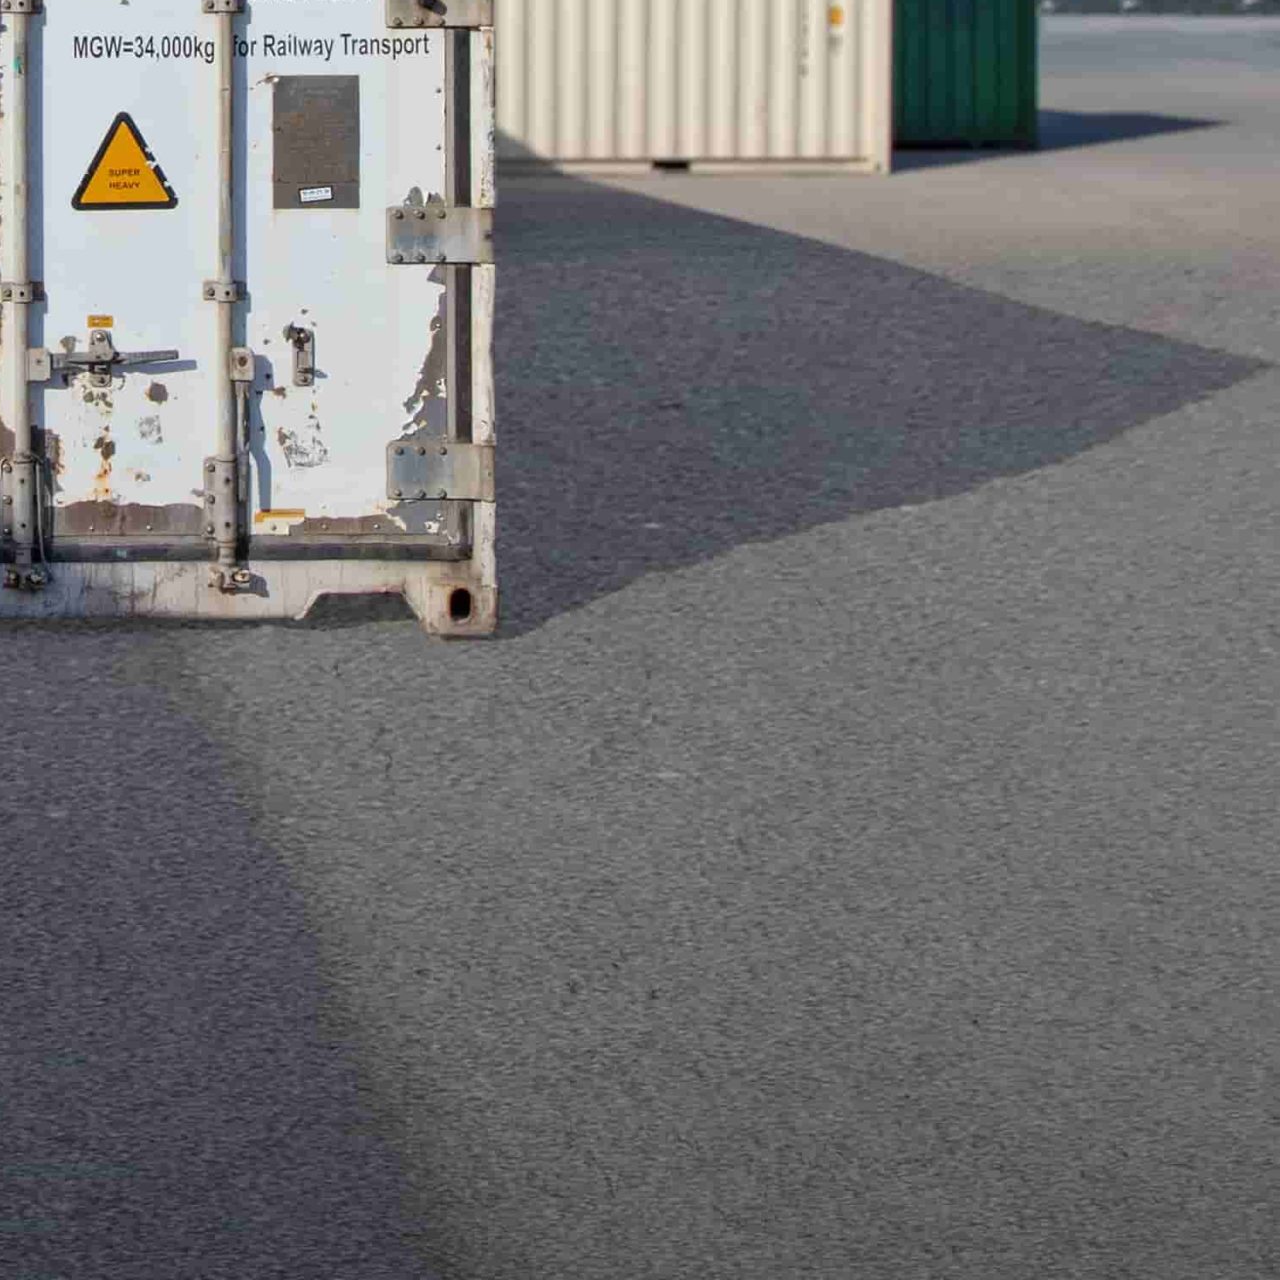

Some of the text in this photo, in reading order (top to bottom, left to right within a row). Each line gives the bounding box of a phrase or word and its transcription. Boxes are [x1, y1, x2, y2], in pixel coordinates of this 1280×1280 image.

[73, 33, 430, 65] MGW=34,000kg for Railway Transport
[108, 168, 141, 177] SUPER
[108, 181, 141, 190] HEAVY
